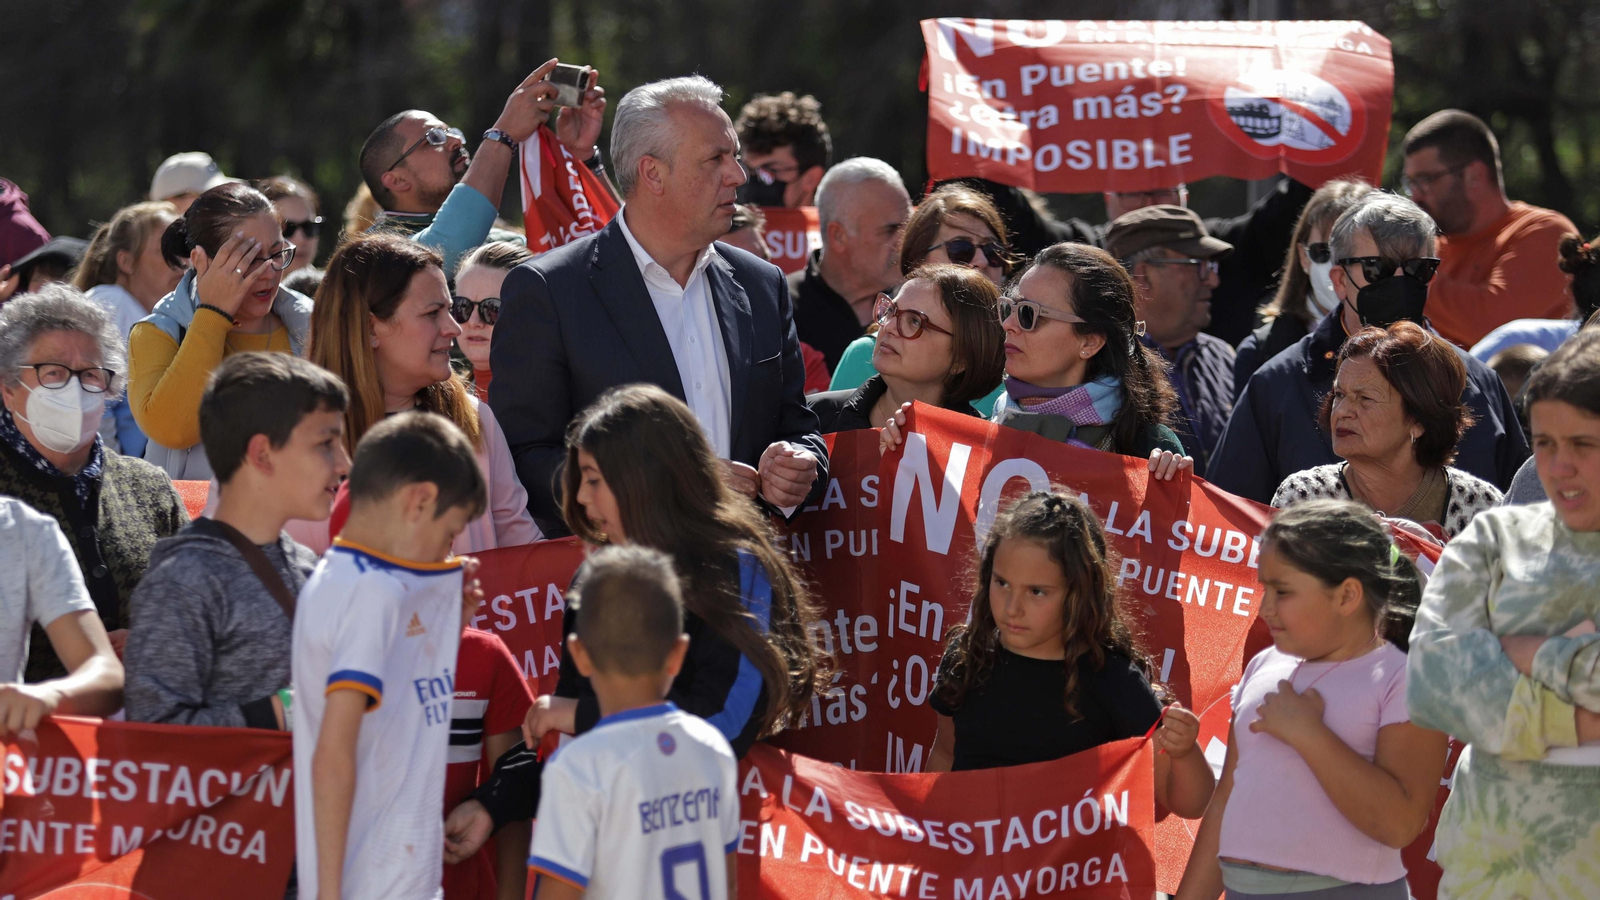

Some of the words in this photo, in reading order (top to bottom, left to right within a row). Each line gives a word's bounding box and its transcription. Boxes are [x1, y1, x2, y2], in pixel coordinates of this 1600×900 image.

[936, 18, 1067, 61] NO
[943, 72, 1007, 99] ¡En
[1020, 55, 1187, 96] Puente!
[1072, 84, 1188, 121] más?
[951, 127, 1193, 172] IMPOSIBLE
[803, 477, 847, 513] A
[1105, 501, 1153, 544] LA
[1118, 557, 1254, 616] PUENTE
[888, 580, 944, 641] ¡En
[512, 642, 562, 680] MA
[425, 701, 447, 726] FLY
[742, 766, 768, 799] A
[782, 775, 832, 822] LA
[844, 788, 1129, 856] SUBESTACIÓN
[737, 820, 787, 859] EN
[801, 832, 939, 899] PUENTE
[954, 853, 1129, 900] MAYORGA
